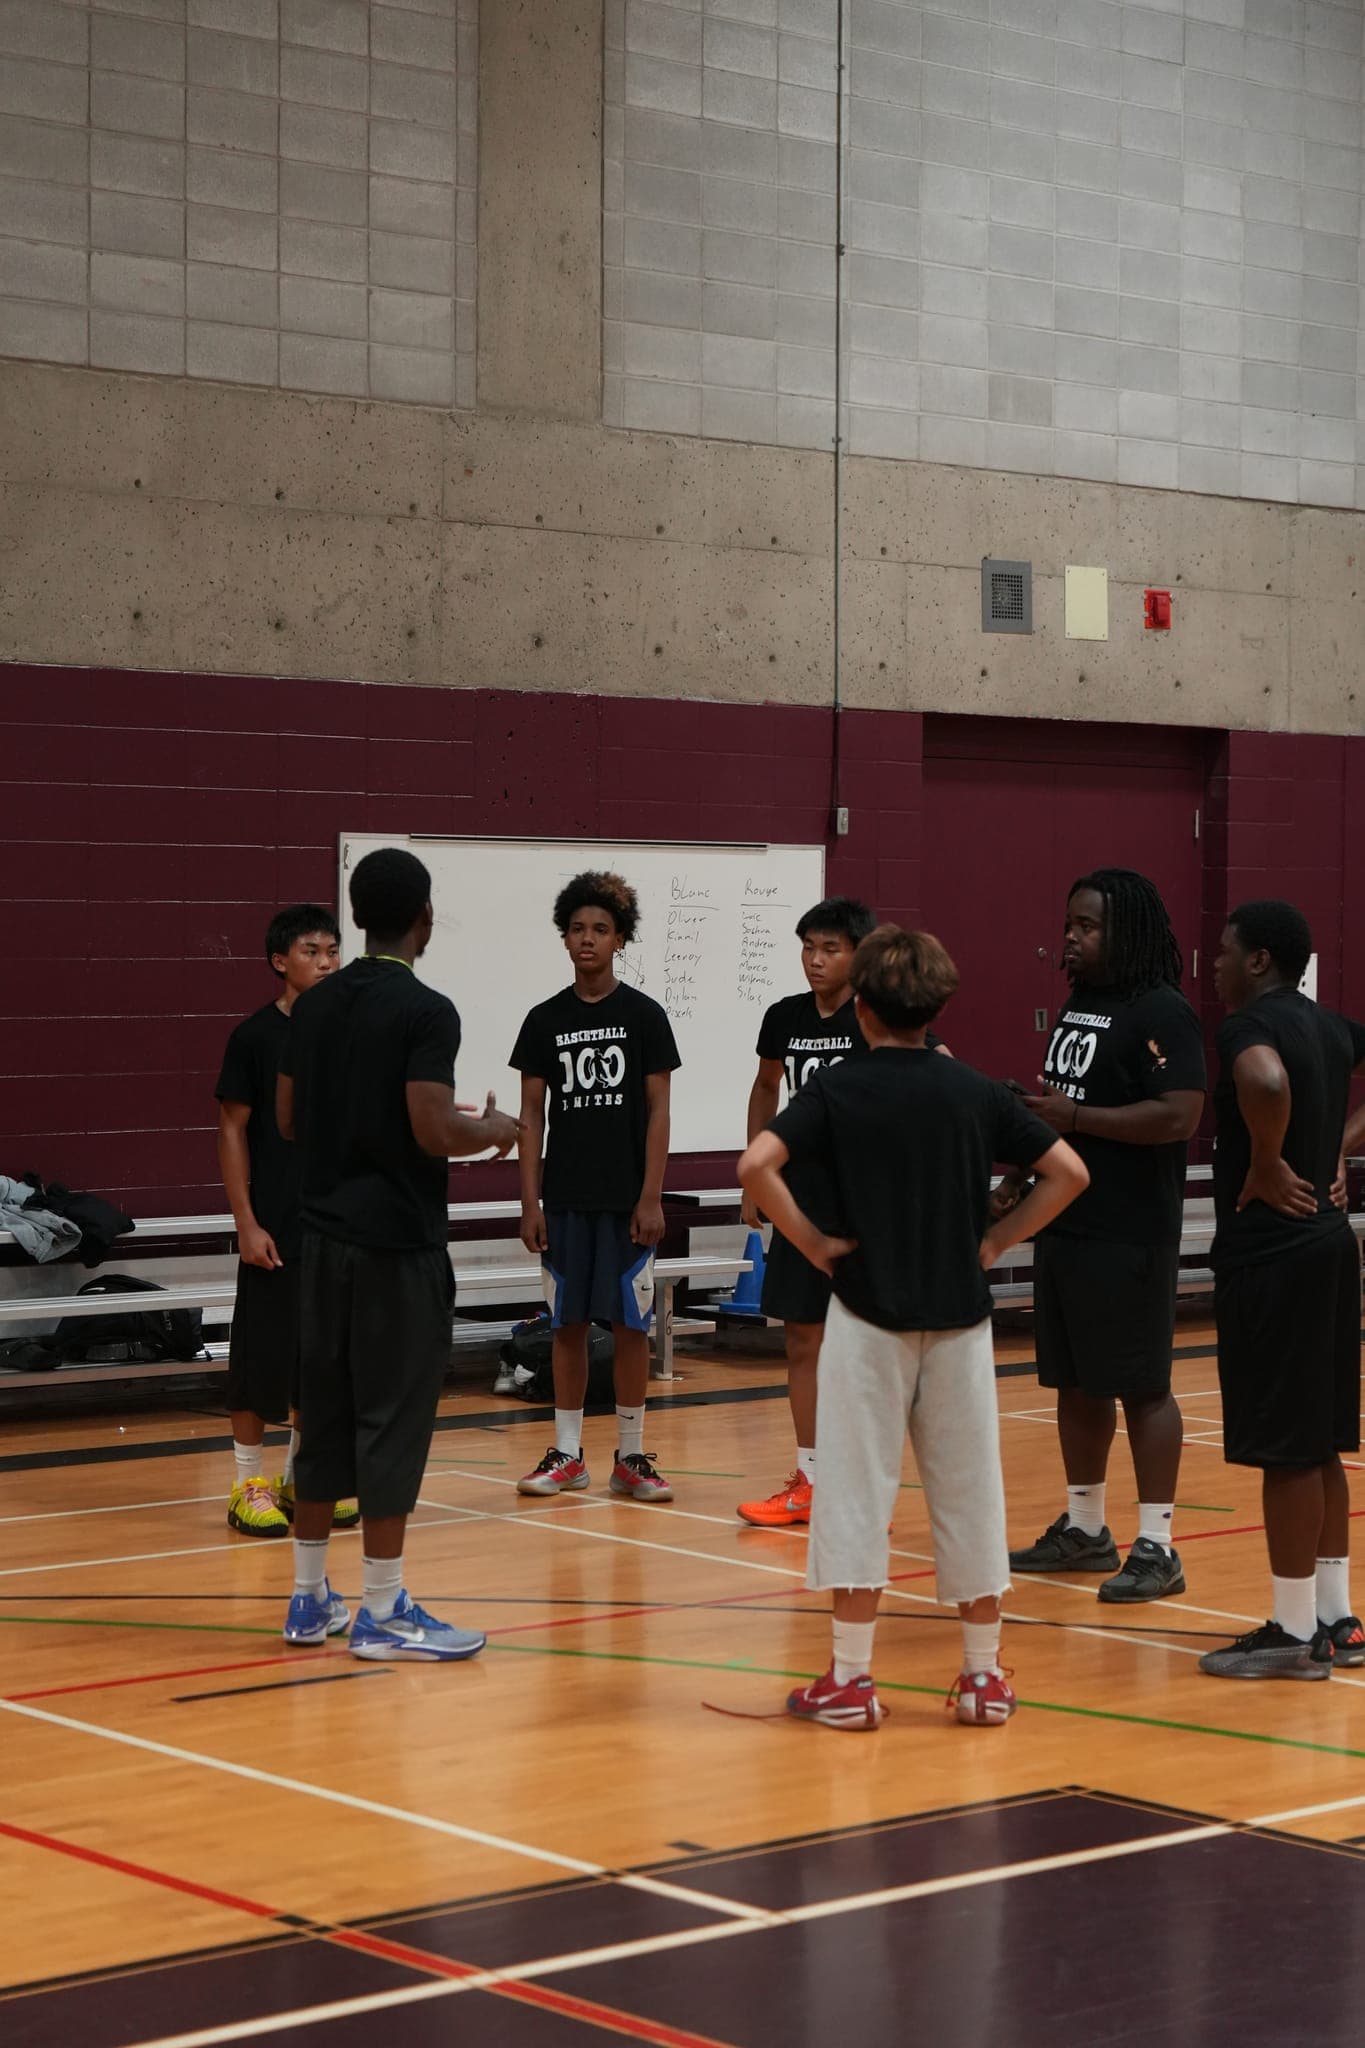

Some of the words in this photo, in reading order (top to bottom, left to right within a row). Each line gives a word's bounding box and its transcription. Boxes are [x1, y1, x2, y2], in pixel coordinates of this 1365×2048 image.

[744, 878, 778, 897] Rouge
[667, 909, 707, 925] Oliver
[664, 968, 696, 983] Jude
[739, 960, 768, 972] Marco
[555, 1027, 627, 1047] BASKETBALL
[1045, 1027, 1097, 1078] 100
[559, 1045, 625, 1093] 100
[665, 1310, 672, 1336] 6
